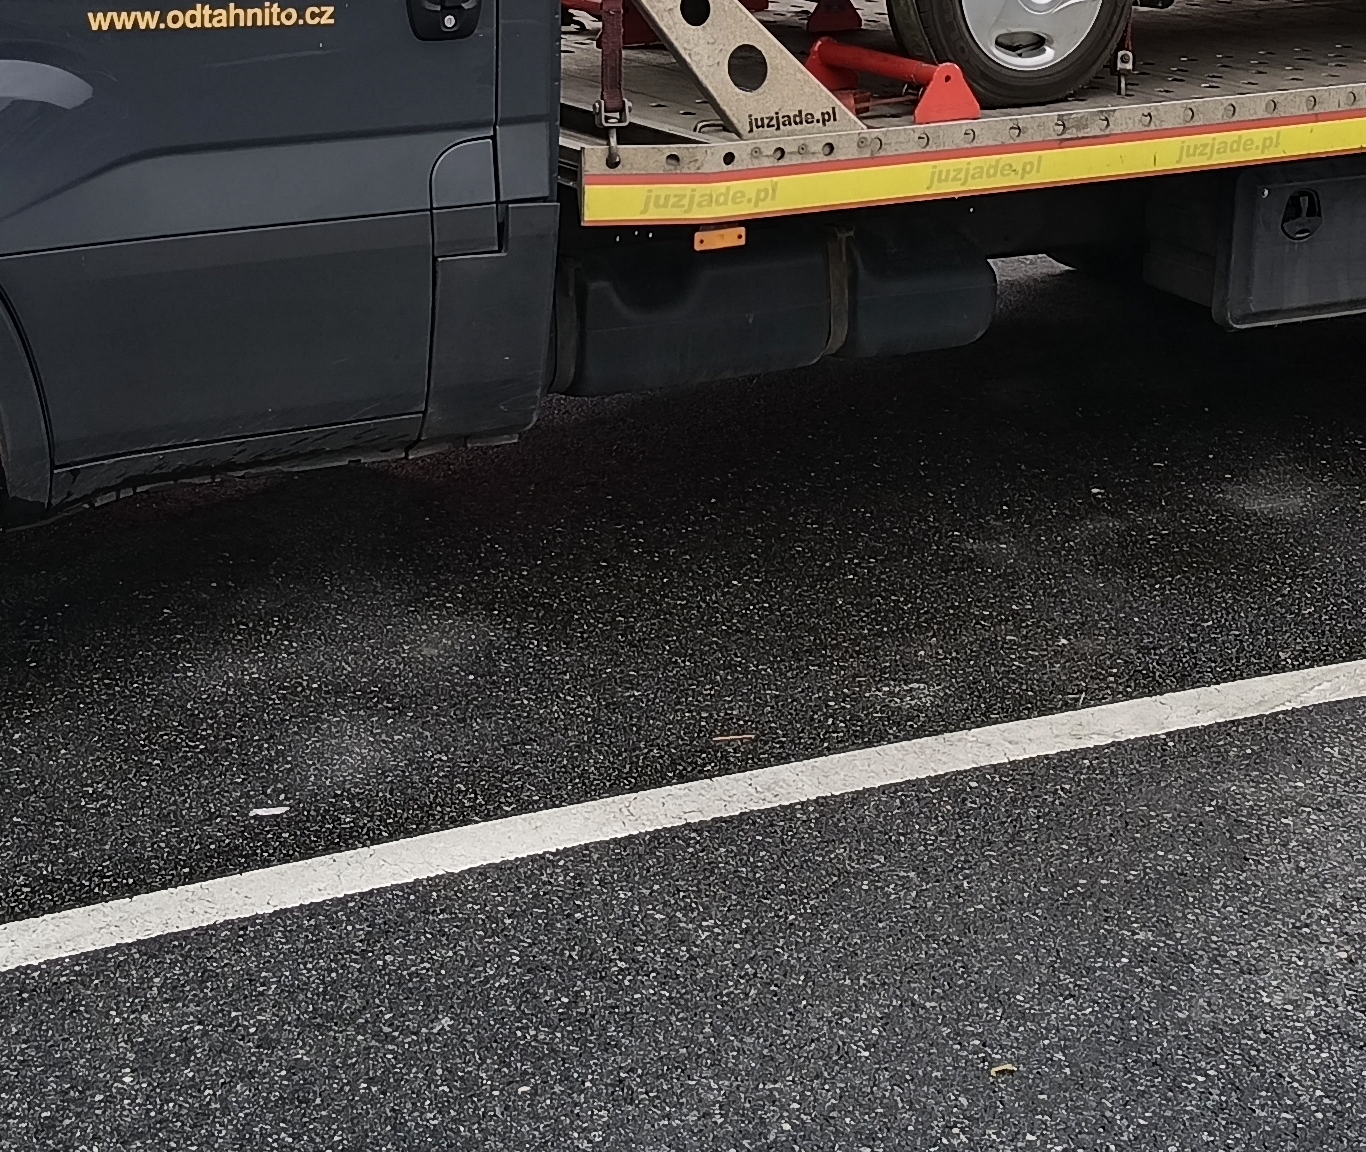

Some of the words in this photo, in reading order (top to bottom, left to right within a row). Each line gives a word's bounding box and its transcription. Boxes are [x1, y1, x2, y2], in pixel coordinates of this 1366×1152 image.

[87, 2, 335, 31] www.odtahnito.cz
[748, 107, 838, 133] juzjade.pl
[1176, 131, 1282, 163] juzjade.pl
[926, 155, 1042, 190] juzjade.pl
[640, 179, 777, 215] juzjade.pl
